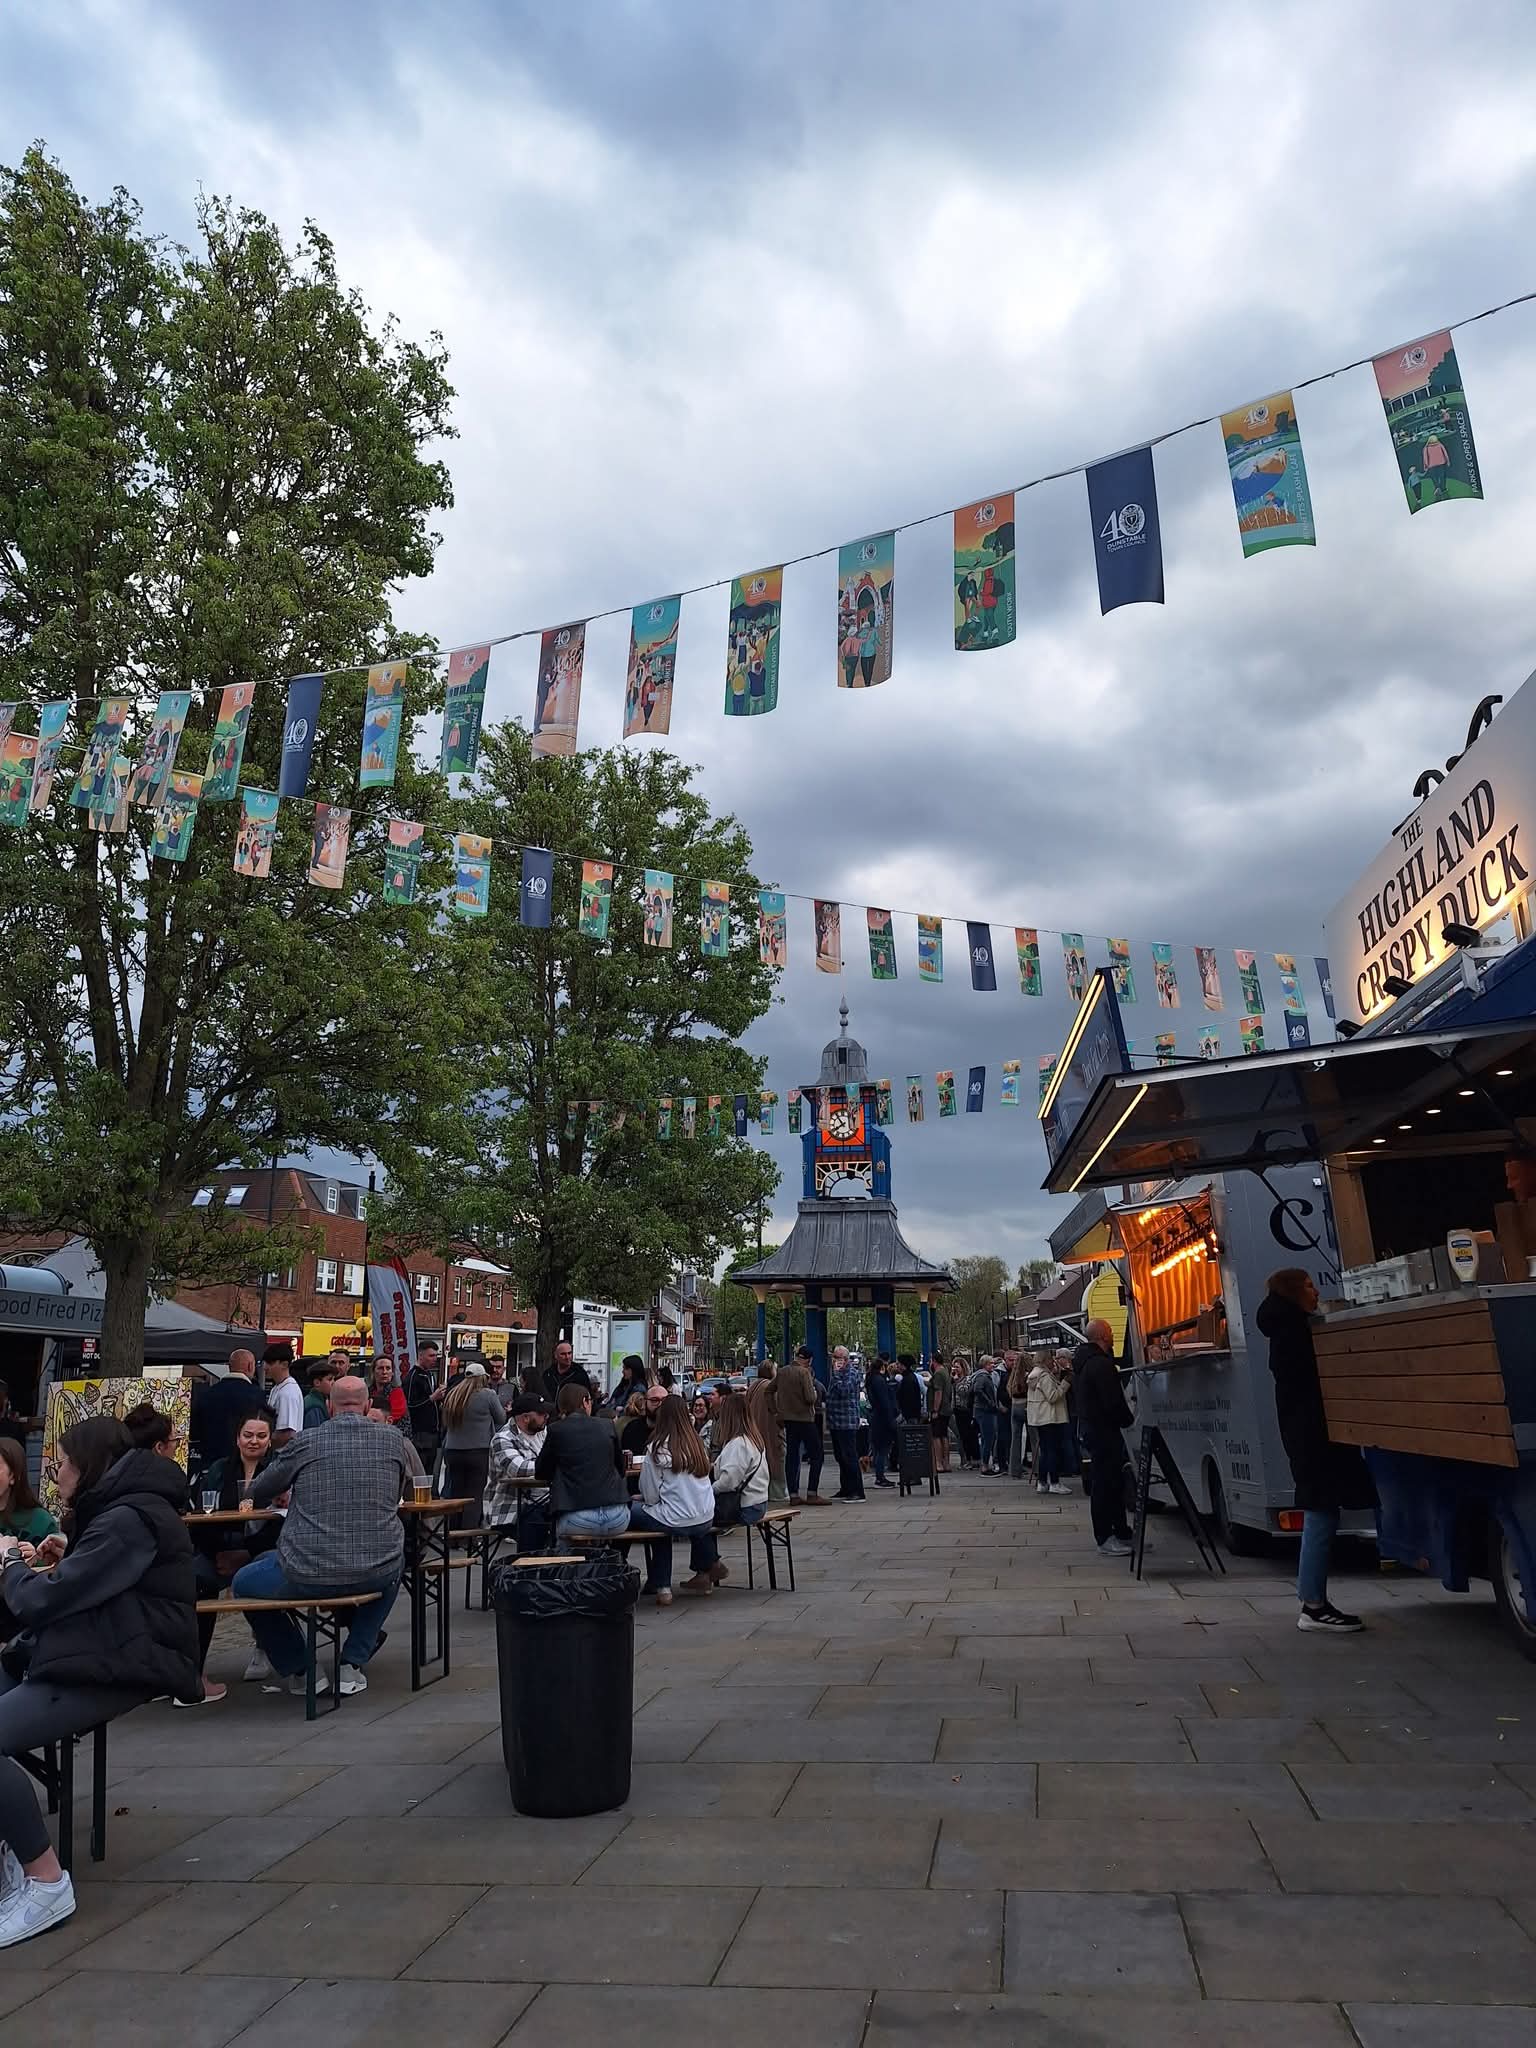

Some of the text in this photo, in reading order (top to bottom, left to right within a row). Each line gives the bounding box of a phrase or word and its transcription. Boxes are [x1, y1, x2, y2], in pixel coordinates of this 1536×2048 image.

[1455, 411, 1468, 438] SPACES
[1461, 439, 1472, 461] OPEN
[1468, 468, 1479, 493] PARKS
[974, 503, 996, 523] 40
[1100, 503, 1146, 543] 40
[1107, 533, 1146, 550] DUNSTABLE
[748, 576, 767, 595] 40
[554, 630, 571, 646] 40
[285, 718, 309, 745] 40
[1401, 815, 1424, 852] THE
[1357, 779, 1496, 956] HIGHLAND
[526, 876, 547, 895] 40
[1356, 823, 1529, 1016] CRISPY DUCK
[972, 946, 989, 961] 40
[1289, 1024, 1305, 1037] 40
[0, 1296, 104, 1322] ood Fired Piz
[82, 1352, 93, 1360] HOT
